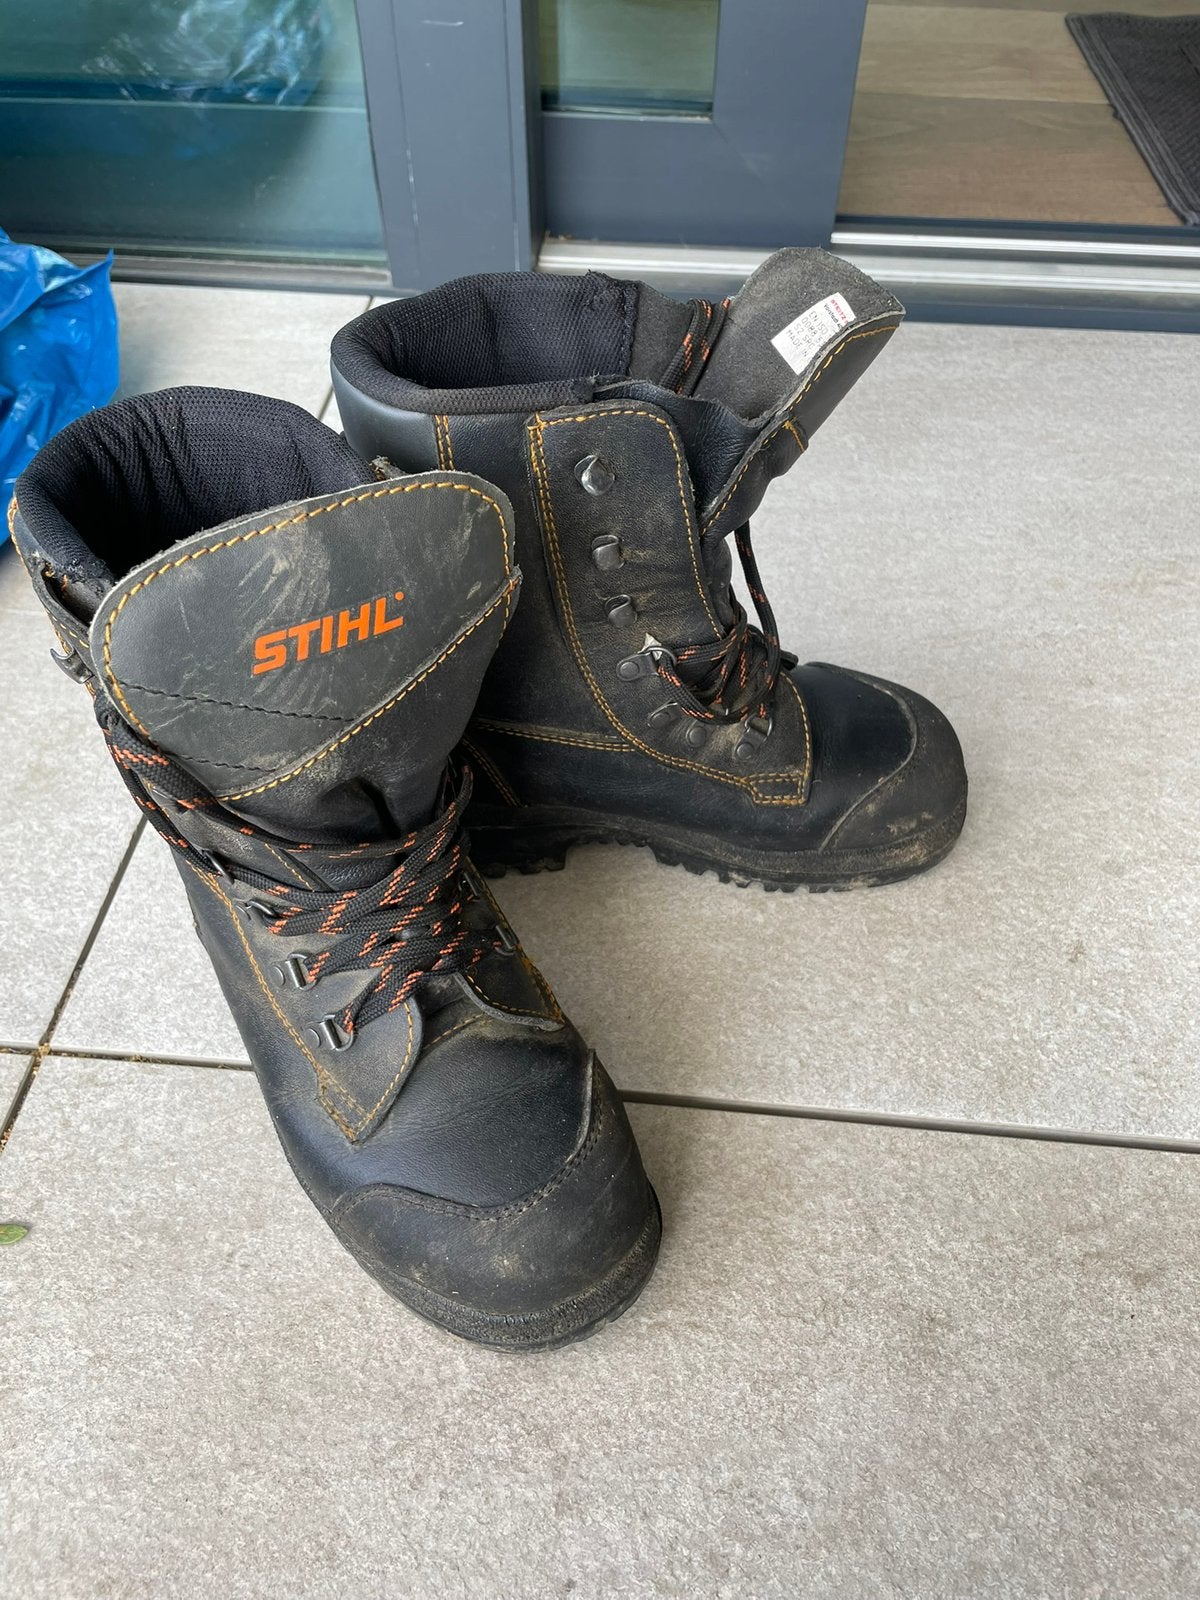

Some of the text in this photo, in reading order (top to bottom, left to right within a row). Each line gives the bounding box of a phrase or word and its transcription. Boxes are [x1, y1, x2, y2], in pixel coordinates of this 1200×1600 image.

[784, 328, 803, 349] MADE
[815, 321, 829, 335] ISO
[253, 592, 404, 675] STIHL
